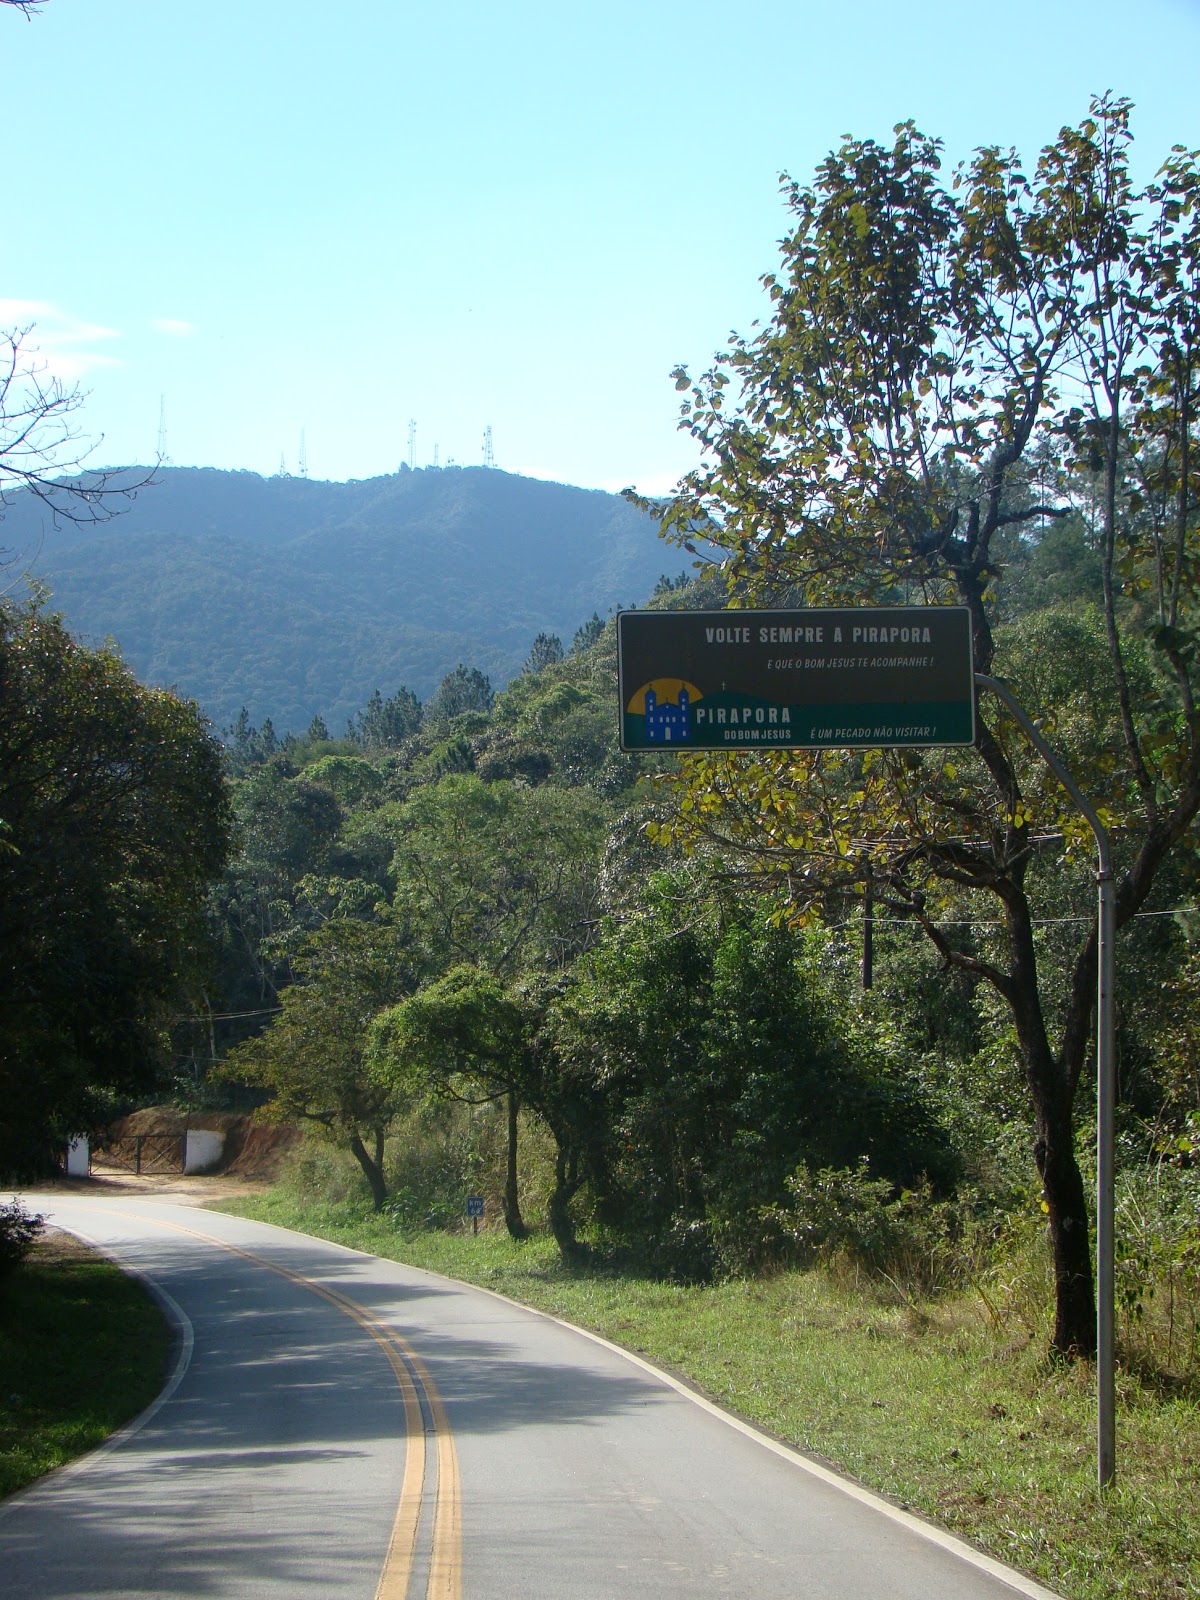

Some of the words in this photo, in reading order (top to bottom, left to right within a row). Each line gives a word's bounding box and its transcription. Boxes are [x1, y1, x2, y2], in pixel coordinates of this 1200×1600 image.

[705, 627, 750, 643] VOLTE
[759, 627, 824, 643] SEMPRE
[833, 627, 843, 643] A
[852, 626, 931, 643] PIRAPORA
[767, 659, 773, 670] E
[774, 659, 793, 670] QUE
[795, 659, 803, 669] O
[804, 658, 825, 669] BOM
[826, 657, 856, 668] JESUS
[857, 657, 869, 668] TE
[870, 656, 928, 668] ACOMPANHE
[696, 707, 791, 724] PIRAPORA
[761, 729, 791, 740] JESUS
[810, 726, 817, 739] É
[818, 728, 833, 739] UM
[835, 727, 872, 739] PECADO
[873, 725, 894, 738] NÃO
[895, 726, 930, 738] VISITAR
